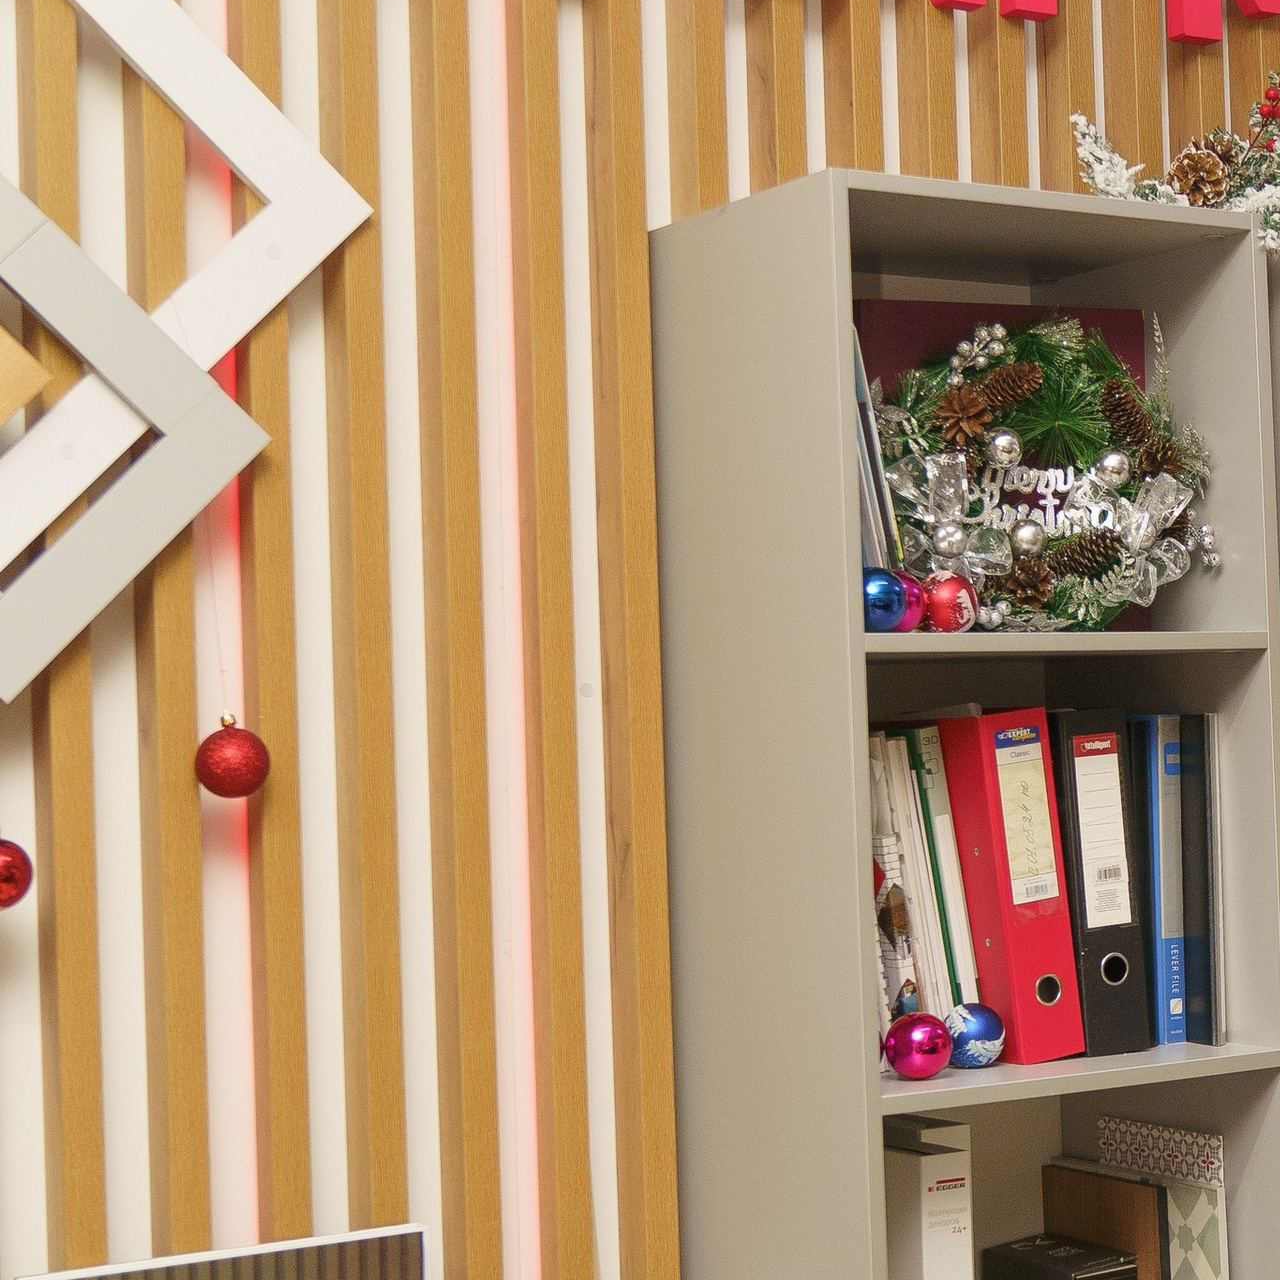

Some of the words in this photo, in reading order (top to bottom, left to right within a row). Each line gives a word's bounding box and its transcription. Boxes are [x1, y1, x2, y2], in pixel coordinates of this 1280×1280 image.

[1008, 728, 1031, 739] EXPERT
[922, 735, 939, 747] 30
[1010, 749, 1031, 758] Classic
[1170, 944, 1179, 972] LEVER
[1171, 975, 1180, 994] FILE
[936, 1182, 966, 1191] EGGER
[951, 1224, 967, 1234] 24+
